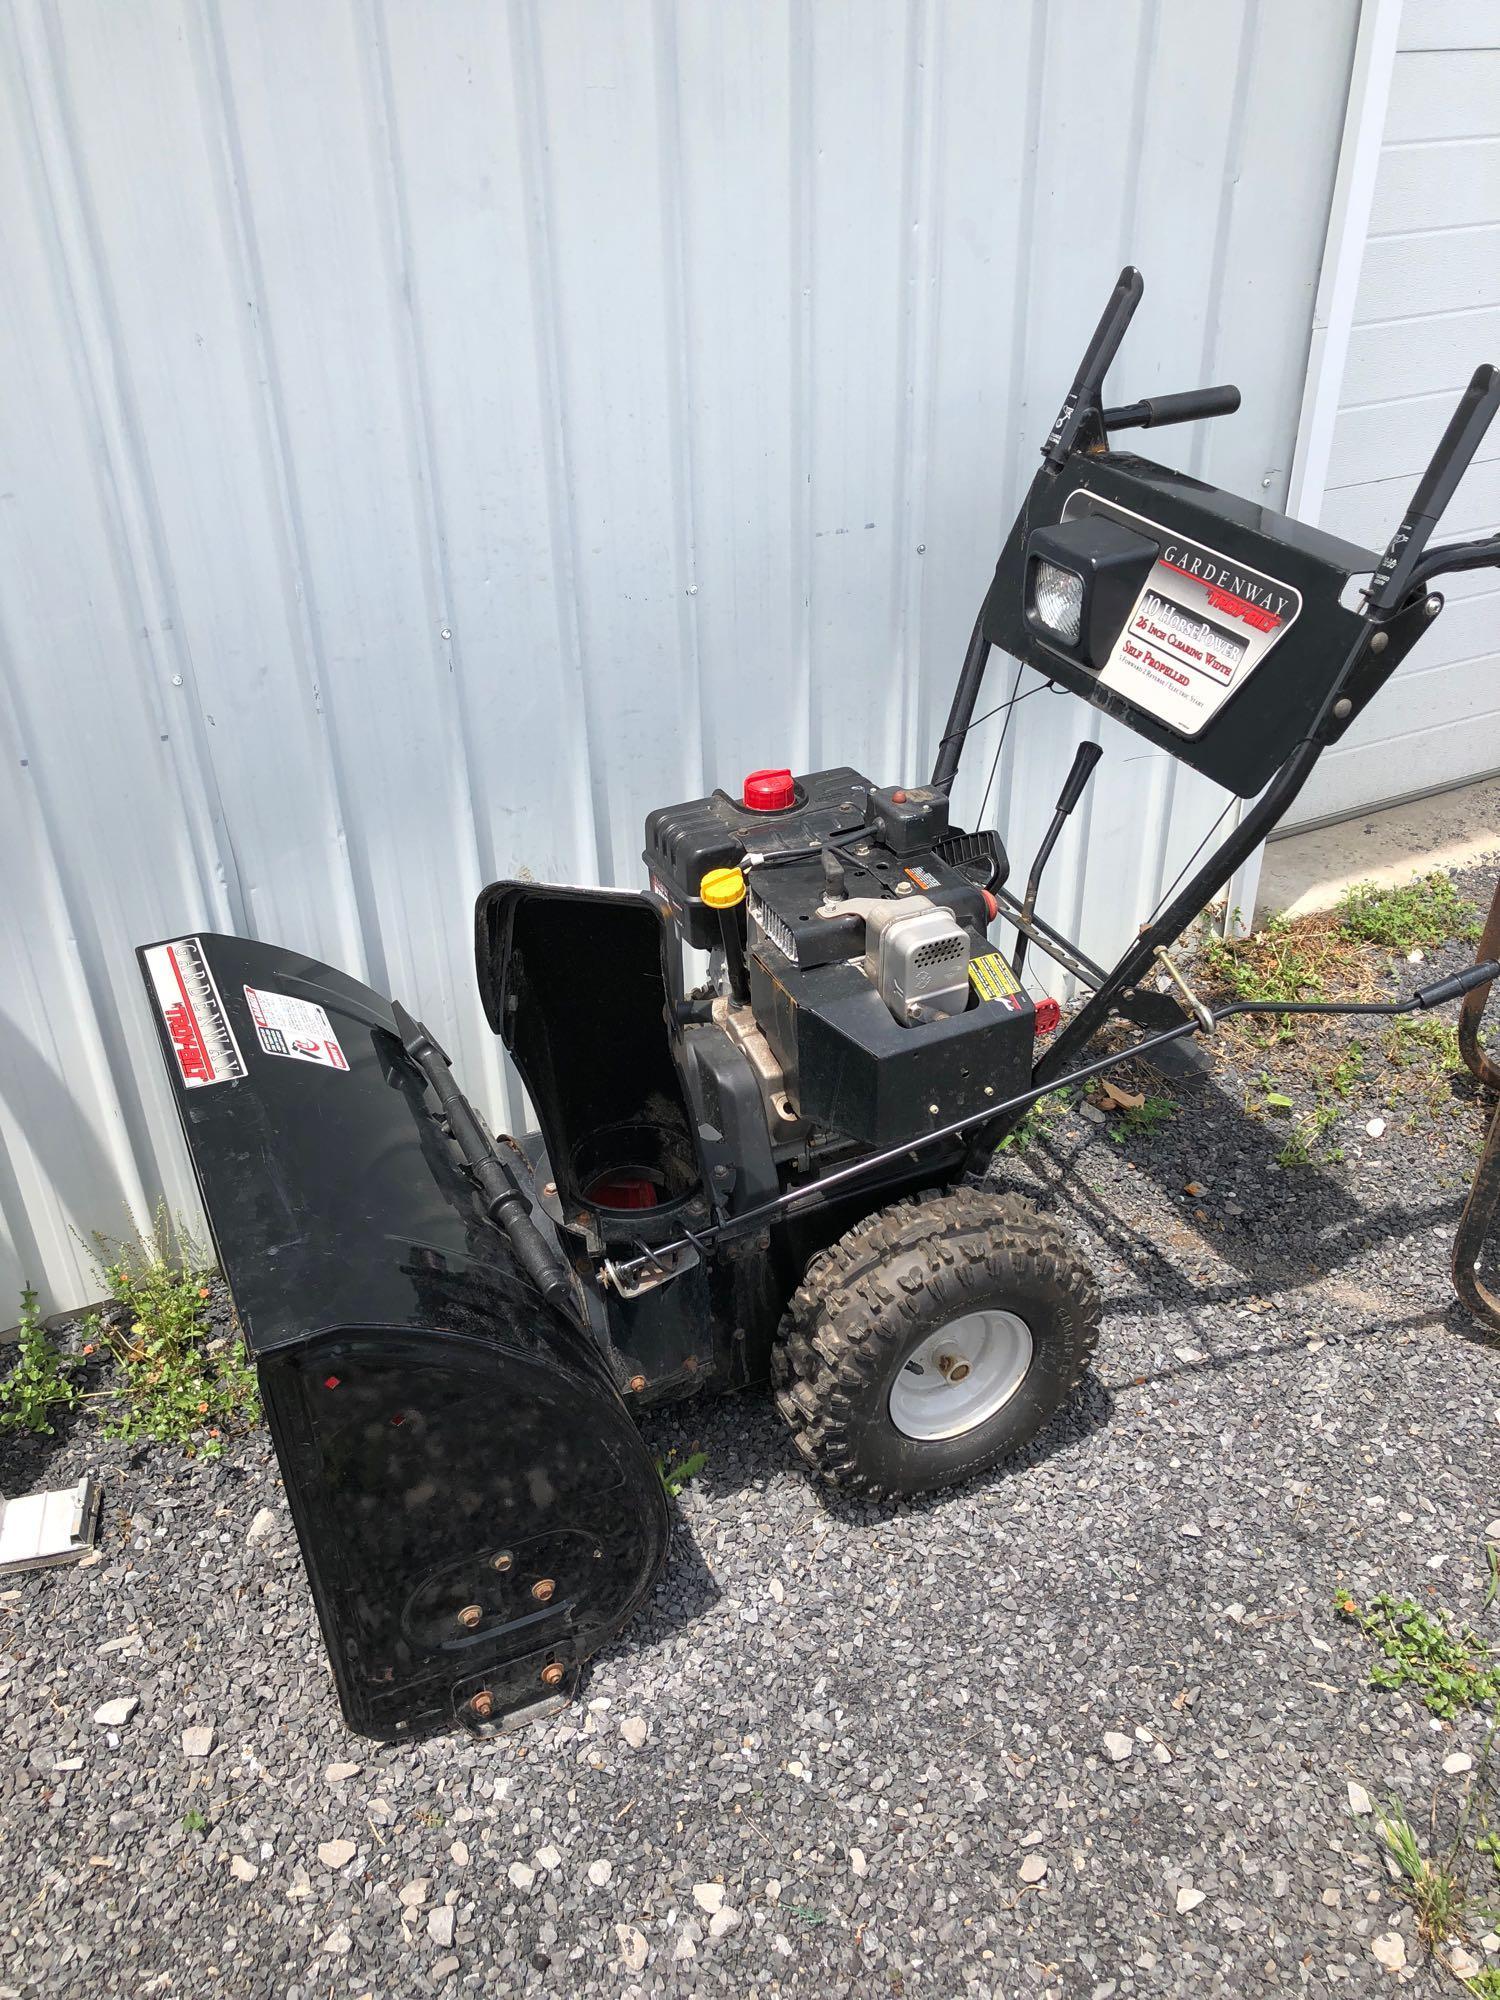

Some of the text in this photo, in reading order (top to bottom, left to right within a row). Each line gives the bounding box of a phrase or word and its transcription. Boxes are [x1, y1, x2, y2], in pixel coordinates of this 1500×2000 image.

[1164, 546, 1289, 615] GARDENWAY
[1135, 615, 1232, 676] 26 INCH CLEARING WIDTH
[1143, 594, 1240, 662] 10 HORSEPOWER
[1122, 639, 1190, 687] SELF PROPELLED
[174, 943, 241, 1073] GARDENWAY
[165, 1004, 209, 1082] TROY-BILT
